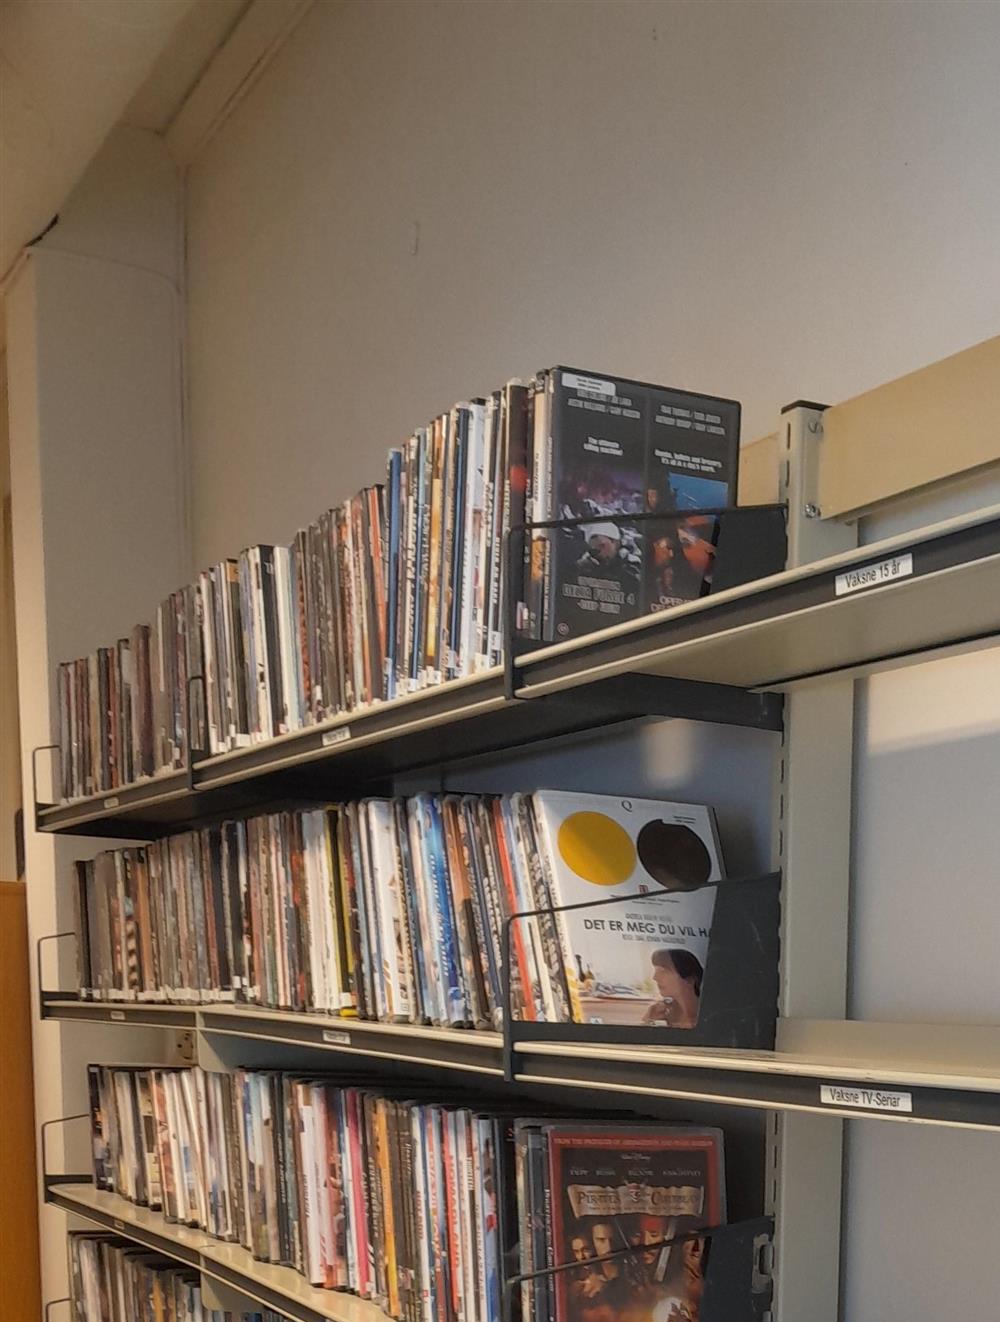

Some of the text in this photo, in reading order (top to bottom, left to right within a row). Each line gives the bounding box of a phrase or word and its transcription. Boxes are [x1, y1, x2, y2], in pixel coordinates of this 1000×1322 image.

[845, 559, 901, 588] Vaksne 15 år
[621, 800, 633, 812] Q
[584, 918, 605, 930] DET
[609, 920, 623, 931] ER
[627, 922, 655, 934] MEG
[659, 924, 675, 935] DU
[678, 926, 696, 937] VIL
[830, 1087, 860, 1103] Vaksne
